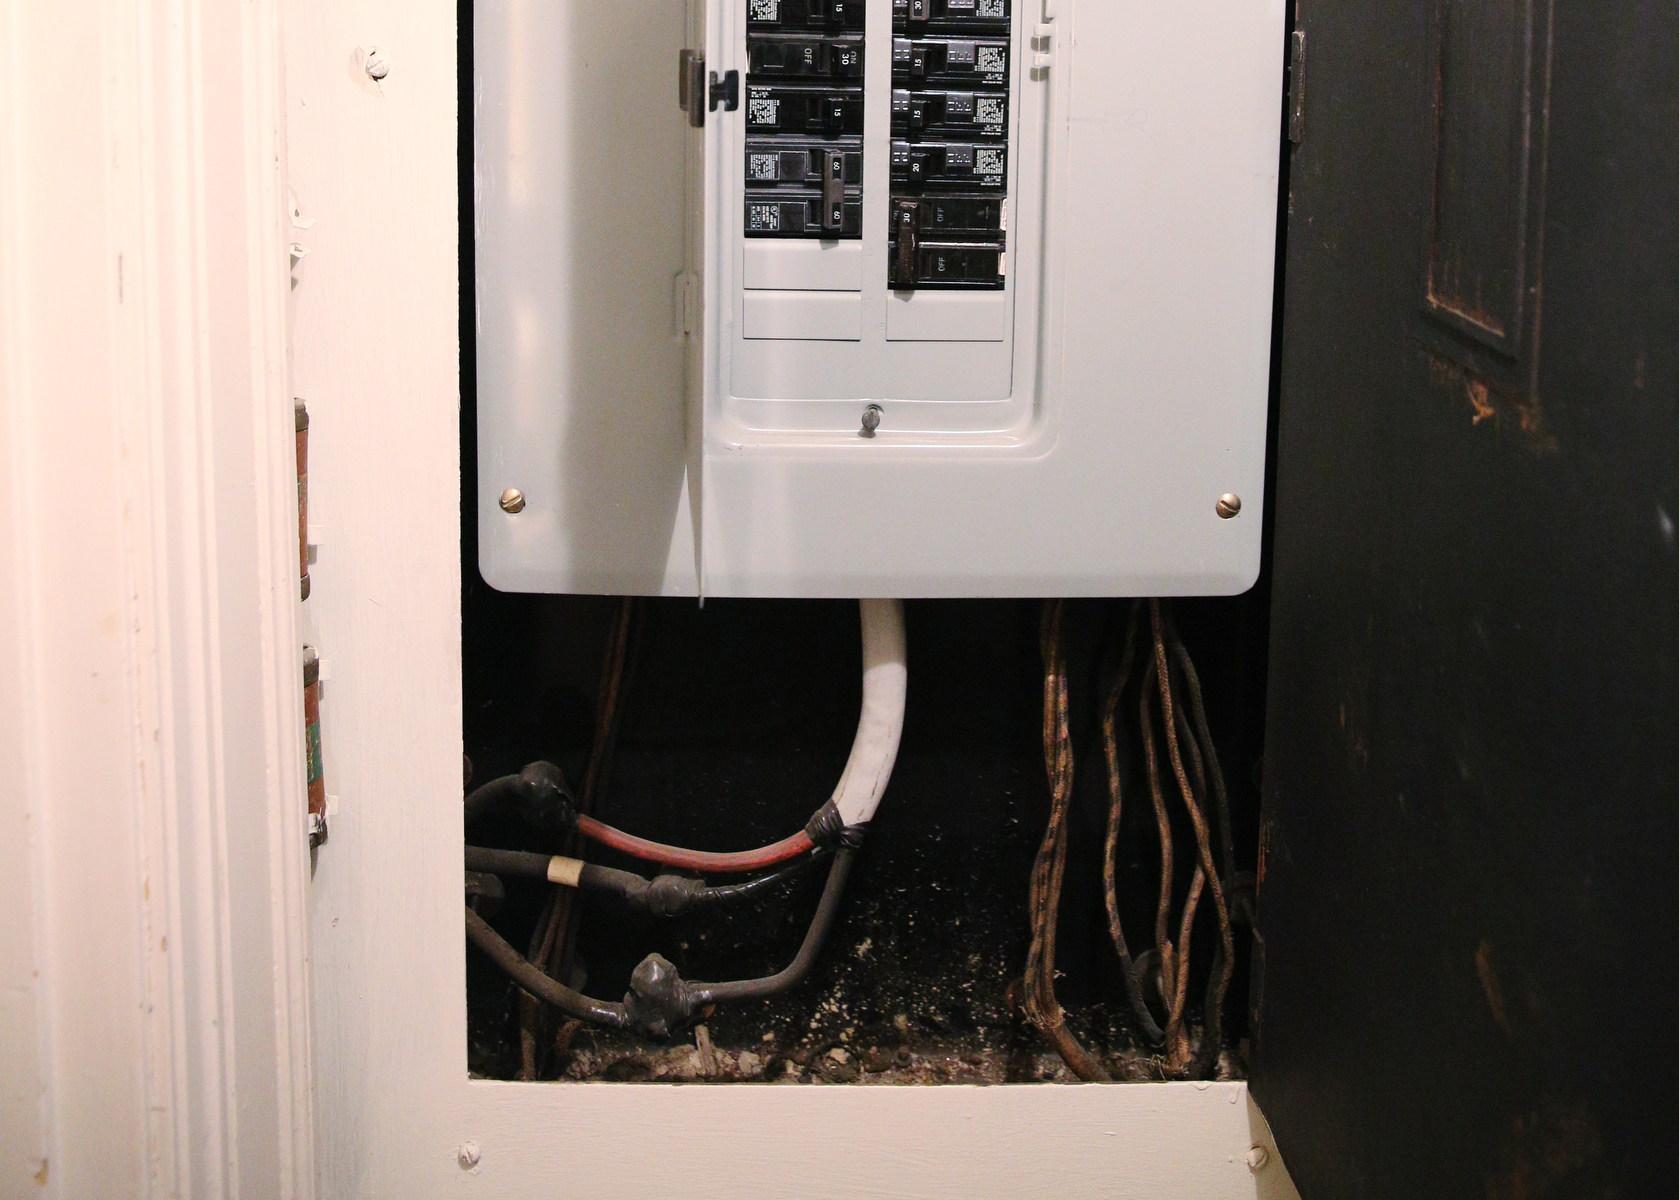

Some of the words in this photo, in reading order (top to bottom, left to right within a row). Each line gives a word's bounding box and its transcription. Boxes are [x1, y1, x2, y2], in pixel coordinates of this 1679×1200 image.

[835, 3, 843, 12] 15
[914, 1, 922, 10] 30
[804, 48, 813, 65] OFF
[841, 53, 850, 65] 30
[914, 58, 922, 67] 15
[834, 108, 841, 117] 15
[913, 110, 921, 118] 15
[833, 161, 841, 171] 60
[912, 163, 920, 173] 20
[833, 211, 841, 220] 60
[903, 212, 911, 223] 30
